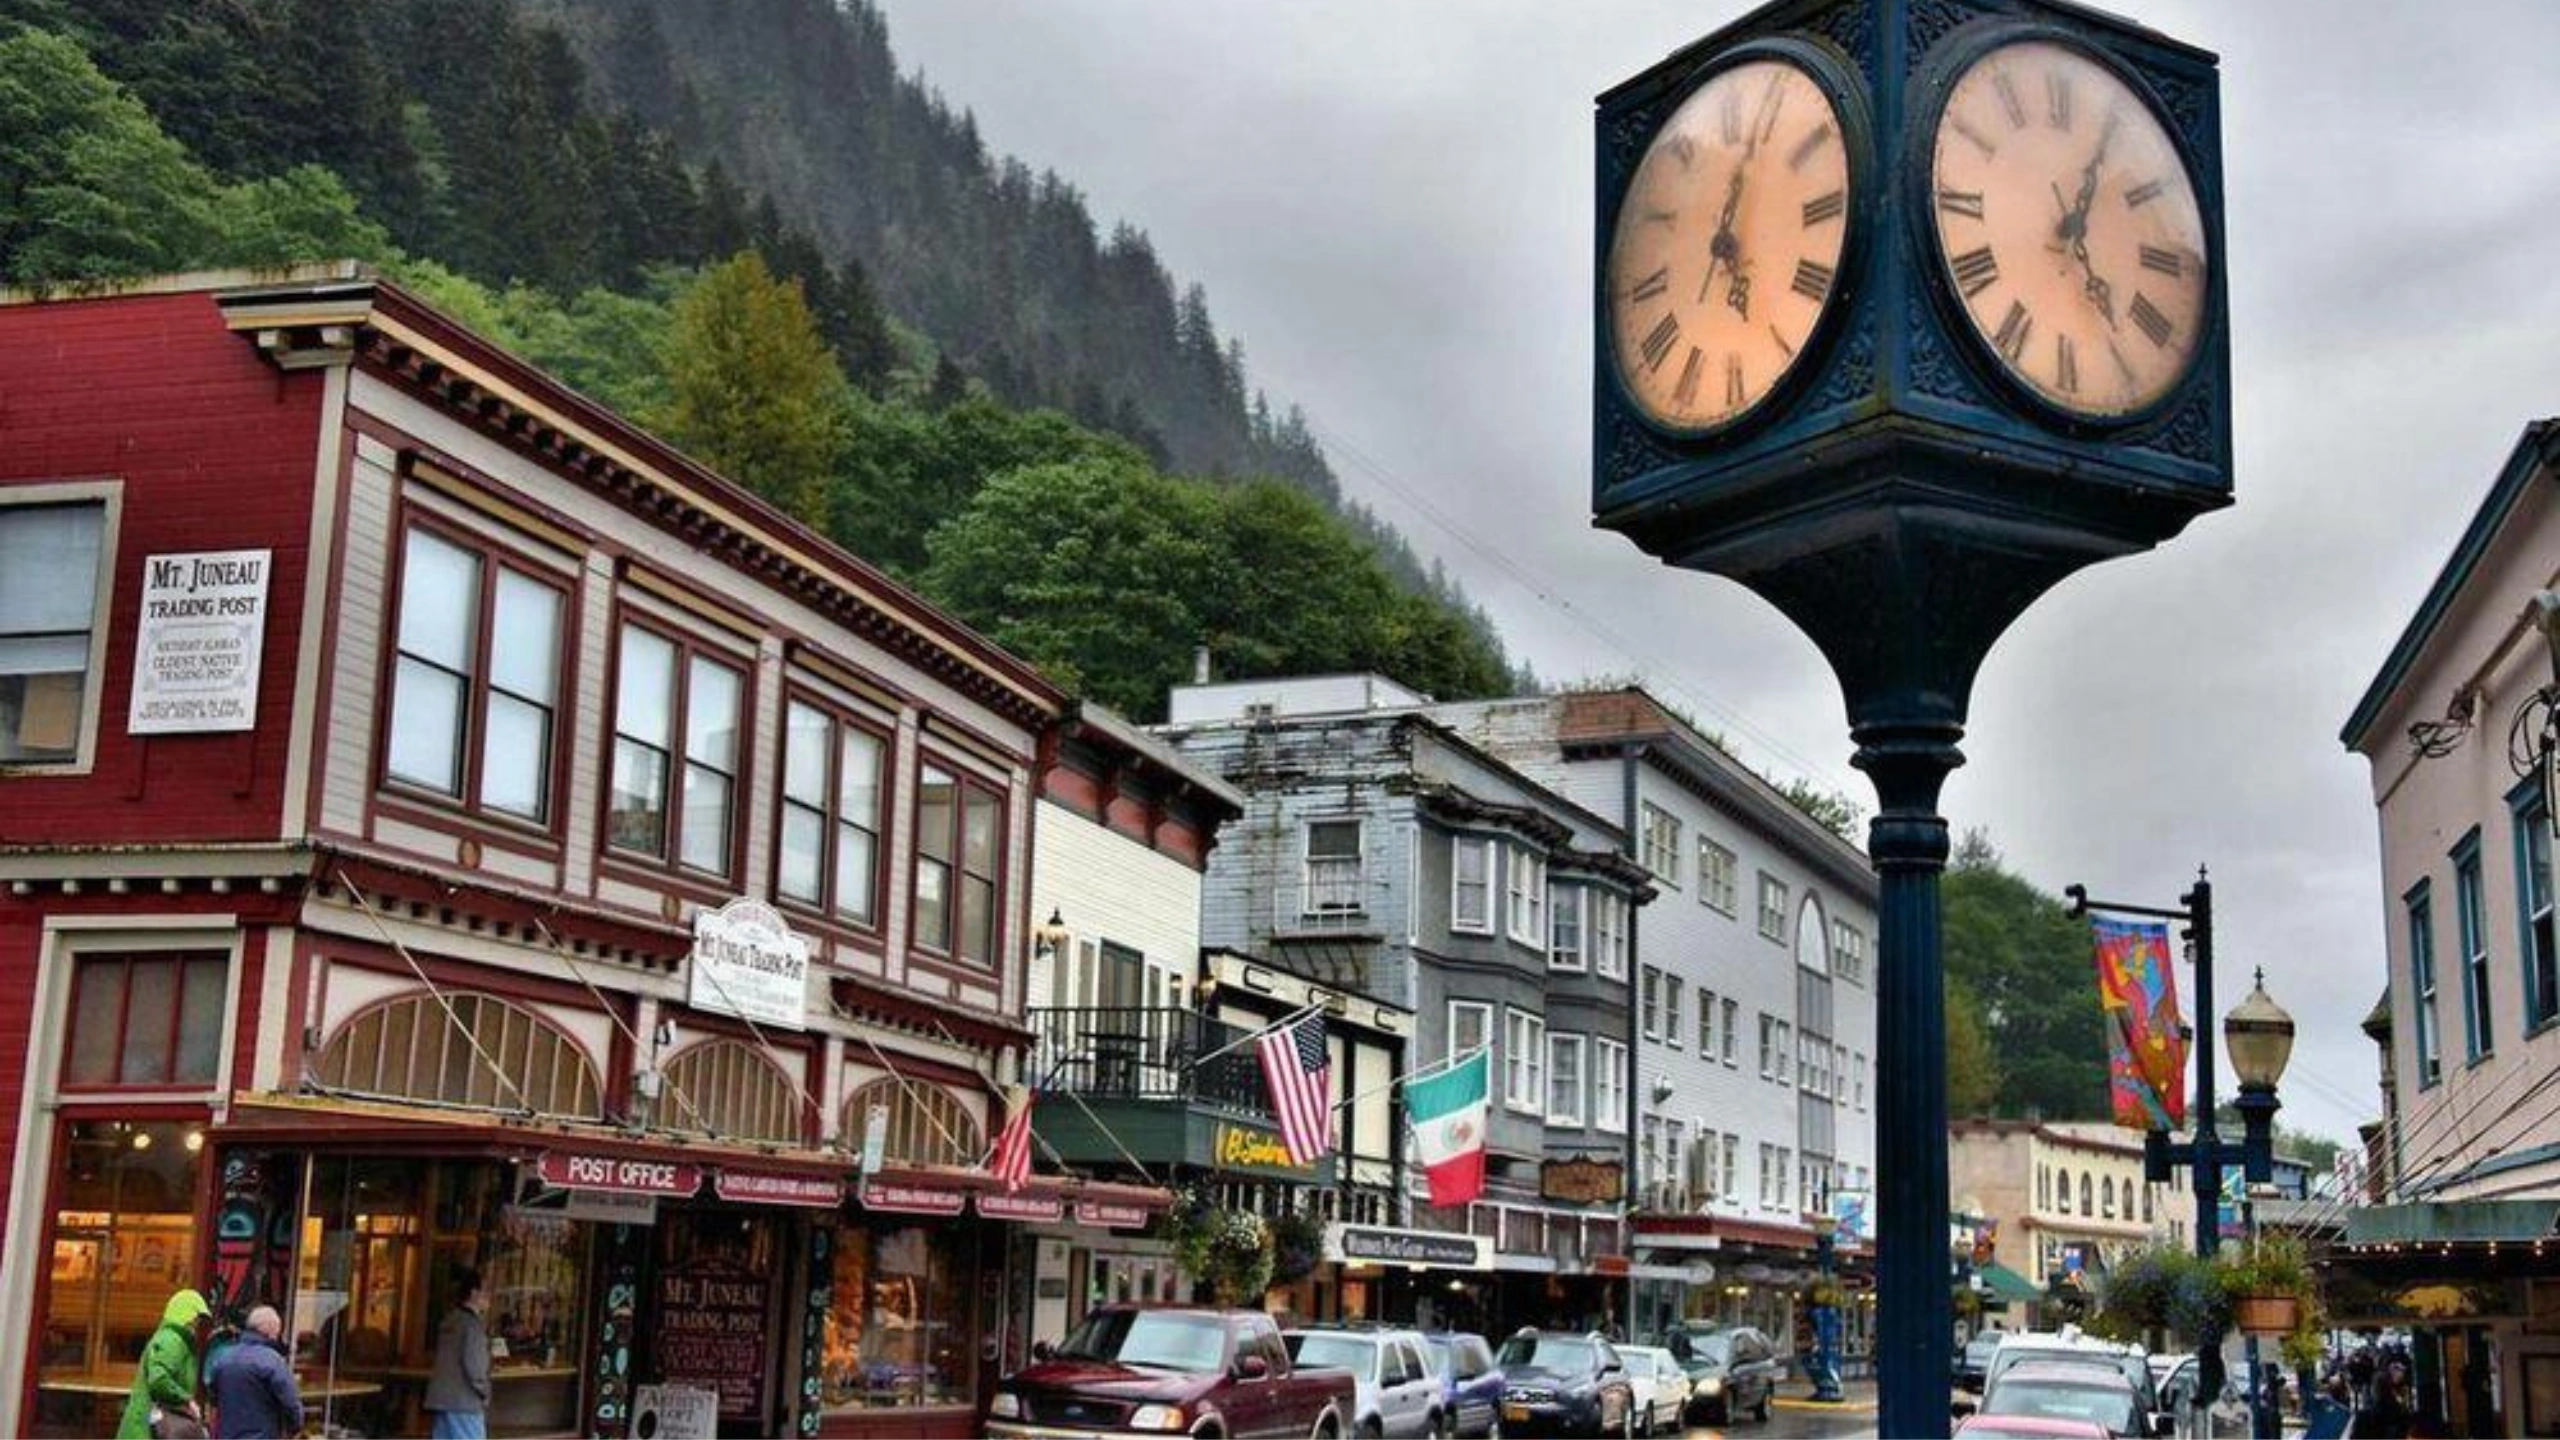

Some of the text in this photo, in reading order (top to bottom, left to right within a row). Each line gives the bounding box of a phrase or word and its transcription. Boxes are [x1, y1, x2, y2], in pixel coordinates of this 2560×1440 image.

[187, 558, 262, 593] JUNEAU
[149, 596, 259, 618] TRADING POST
[568, 1156, 676, 1189] POST OFFICE
[697, 1278, 764, 1310] JUNEAU
